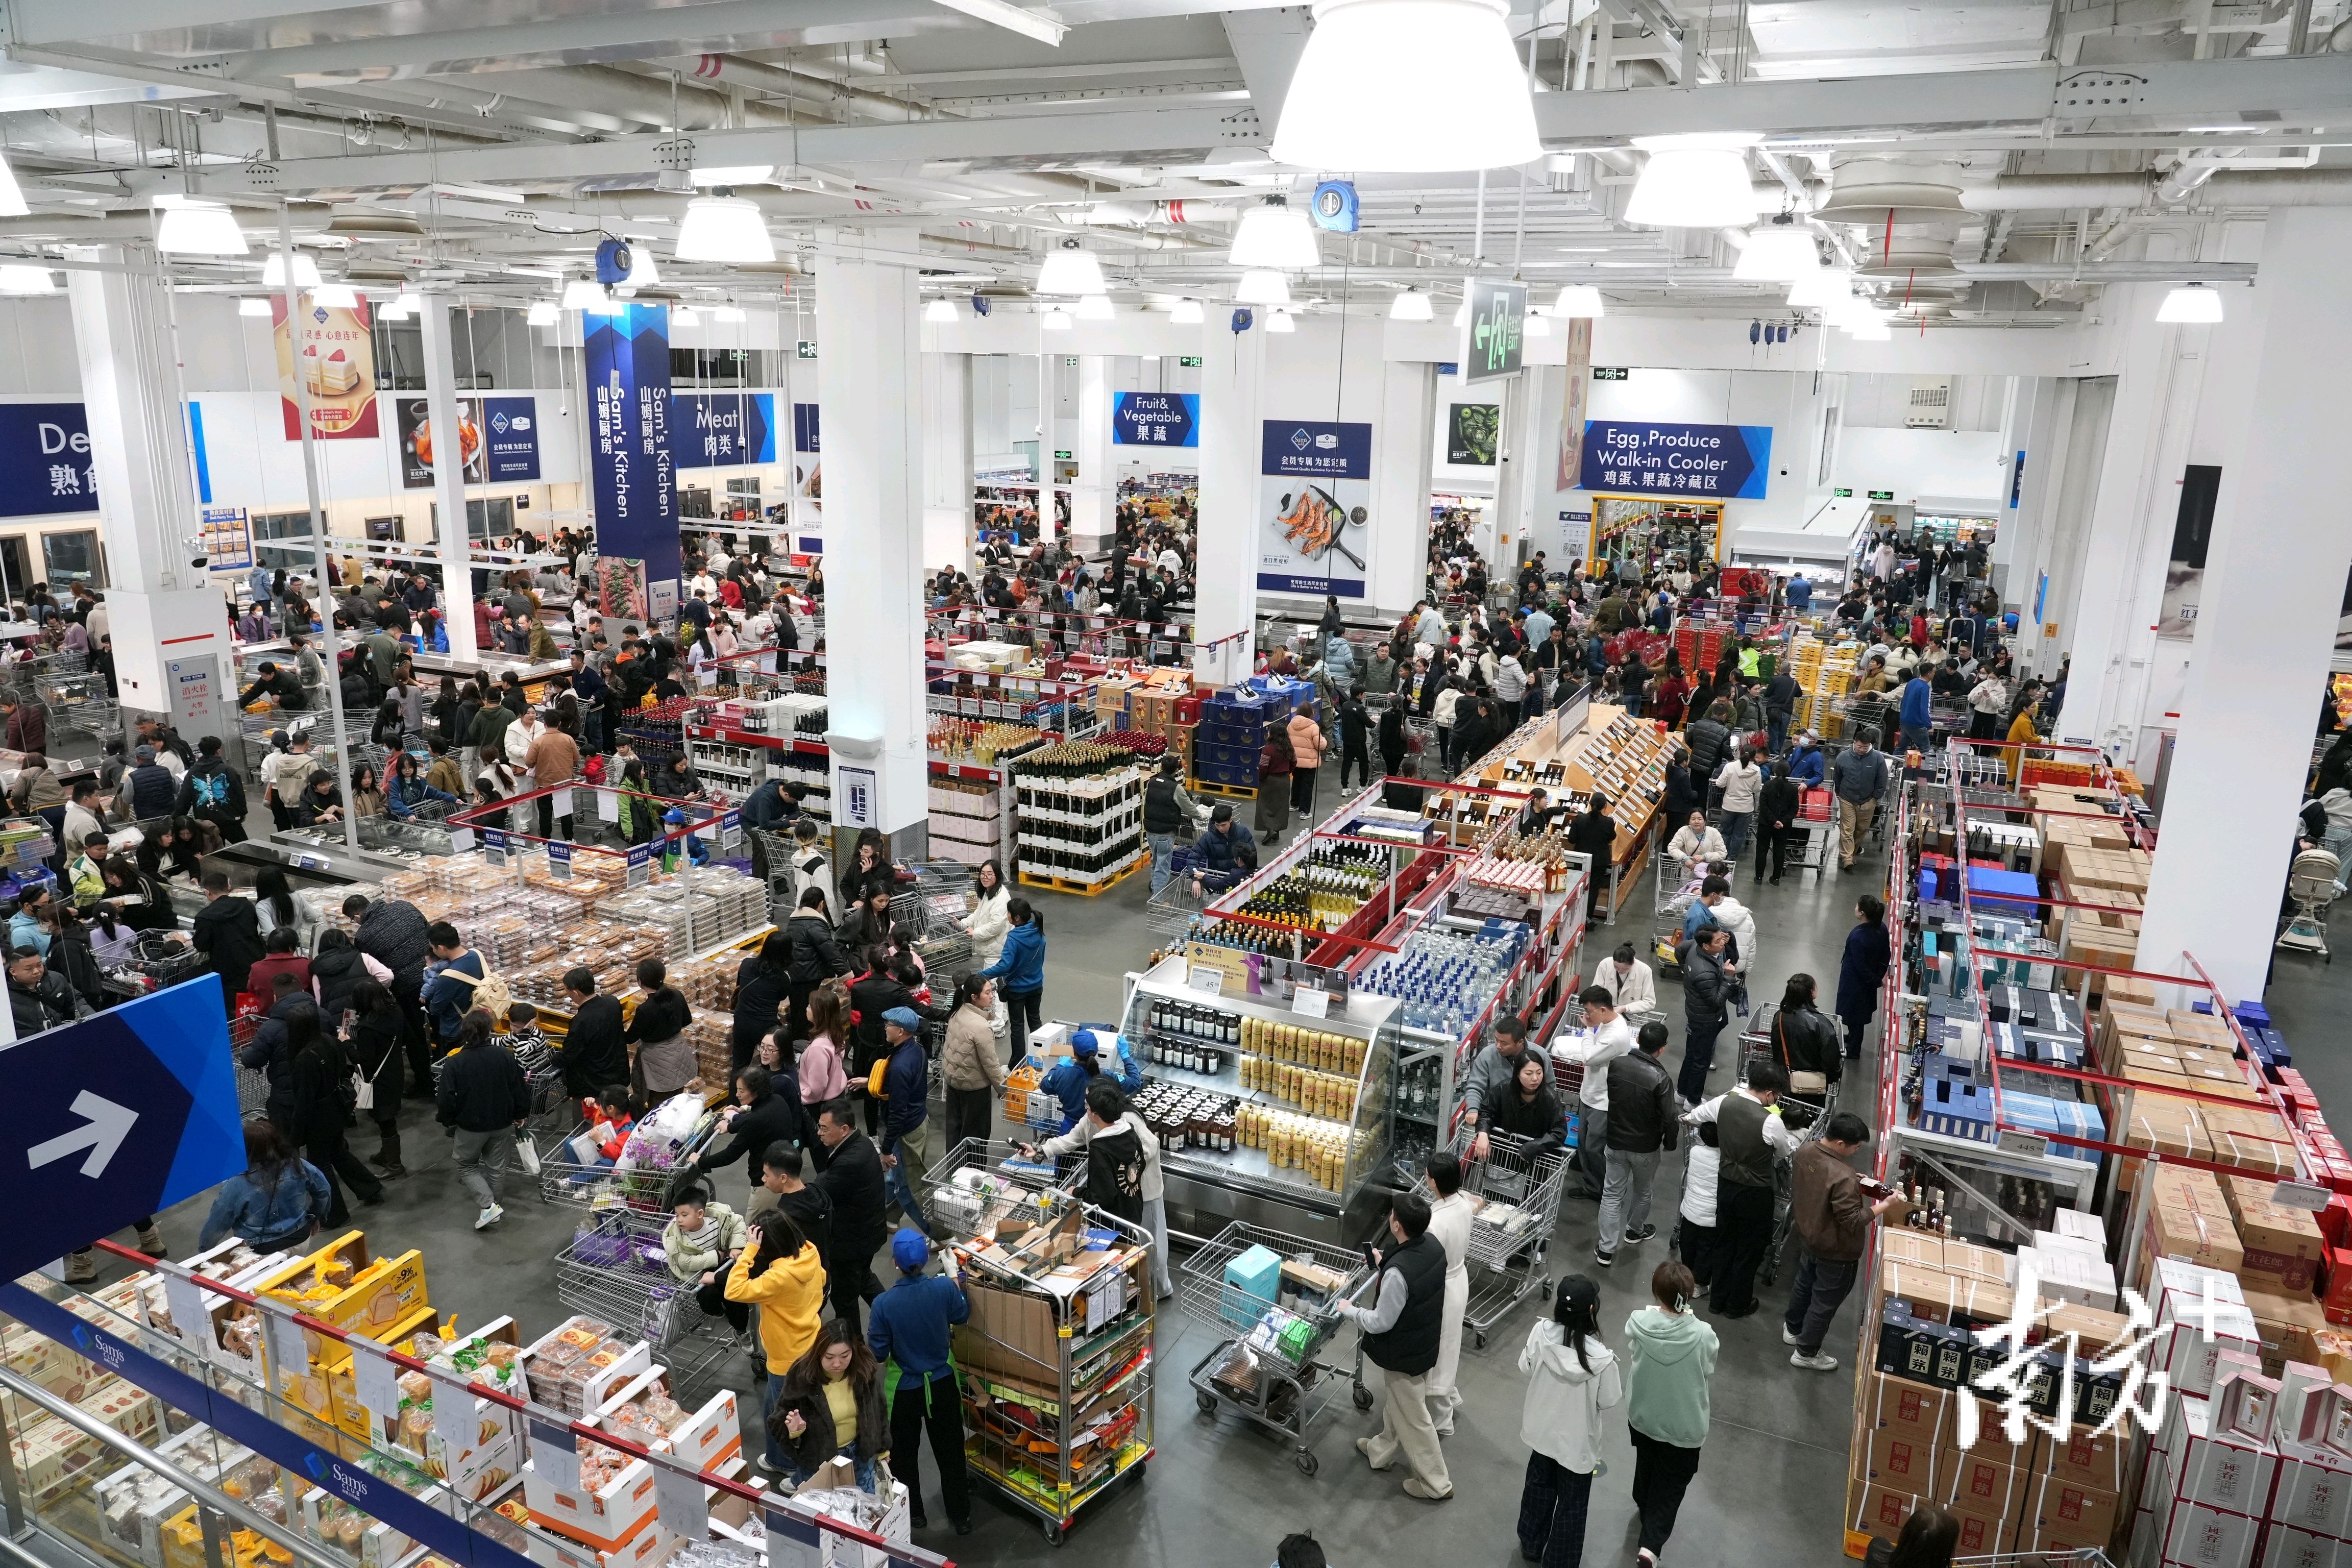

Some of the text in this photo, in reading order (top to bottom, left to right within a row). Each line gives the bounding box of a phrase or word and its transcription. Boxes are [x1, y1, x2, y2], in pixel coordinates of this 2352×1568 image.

[326, 331, 359, 340] 心意连年
[1508, 335, 1518, 350] EXIT
[1136, 397, 1169, 409] Fruit&
[597, 386, 612, 454] 山姆厨房
[641, 386, 654, 455] 山姆厨房
[696, 408, 738, 429] Meat
[1123, 409, 1182, 424] Vegetable
[39, 423, 90, 454] De
[1137, 425, 1166, 441] 果蔬
[1607, 429, 1639, 449] Egg
[611, 388, 630, 518] Sam's Kitchen
[653, 387, 671, 516] Sam's Kitchen
[705, 435, 731, 456] 肉类
[1282, 456, 1347, 467] 会员专属 为您定质
[1598, 450, 1728, 471] Walk-in Cooler
[1603, 471, 1718, 489] 鸡蛋、果蔬冷藏区
[182, 684, 207, 695] 消火栓
[1997, 977, 2023, 986] SINGTON
[239, 1004, 258, 1016] 中国
[2246, 1253, 2284, 1268] 红花郎
[1914, 1305, 1930, 1319] 賴
[95, 1335, 124, 1362] Sam's
[103, 1352, 118, 1363] CLUB
[1913, 1342, 1929, 1371] 賴茅
[1941, 1350, 1957, 1379] 賴茅
[1901, 1392, 1919, 1419] 賴茅
[1893, 1444, 1909, 1471] 賴茅
[2072, 1435, 2092, 1464] 賴茅
[333, 1464, 367, 1494] Sam's
[1976, 1465, 1993, 1494] 賴茅
[342, 1484, 359, 1497] CLUB
[590, 1501, 600, 1512] 16
[1883, 1497, 1900, 1523] 賴茅
[2061, 1488, 2081, 1517] 賴茅
[1963, 1521, 1983, 1547] 賴茅
